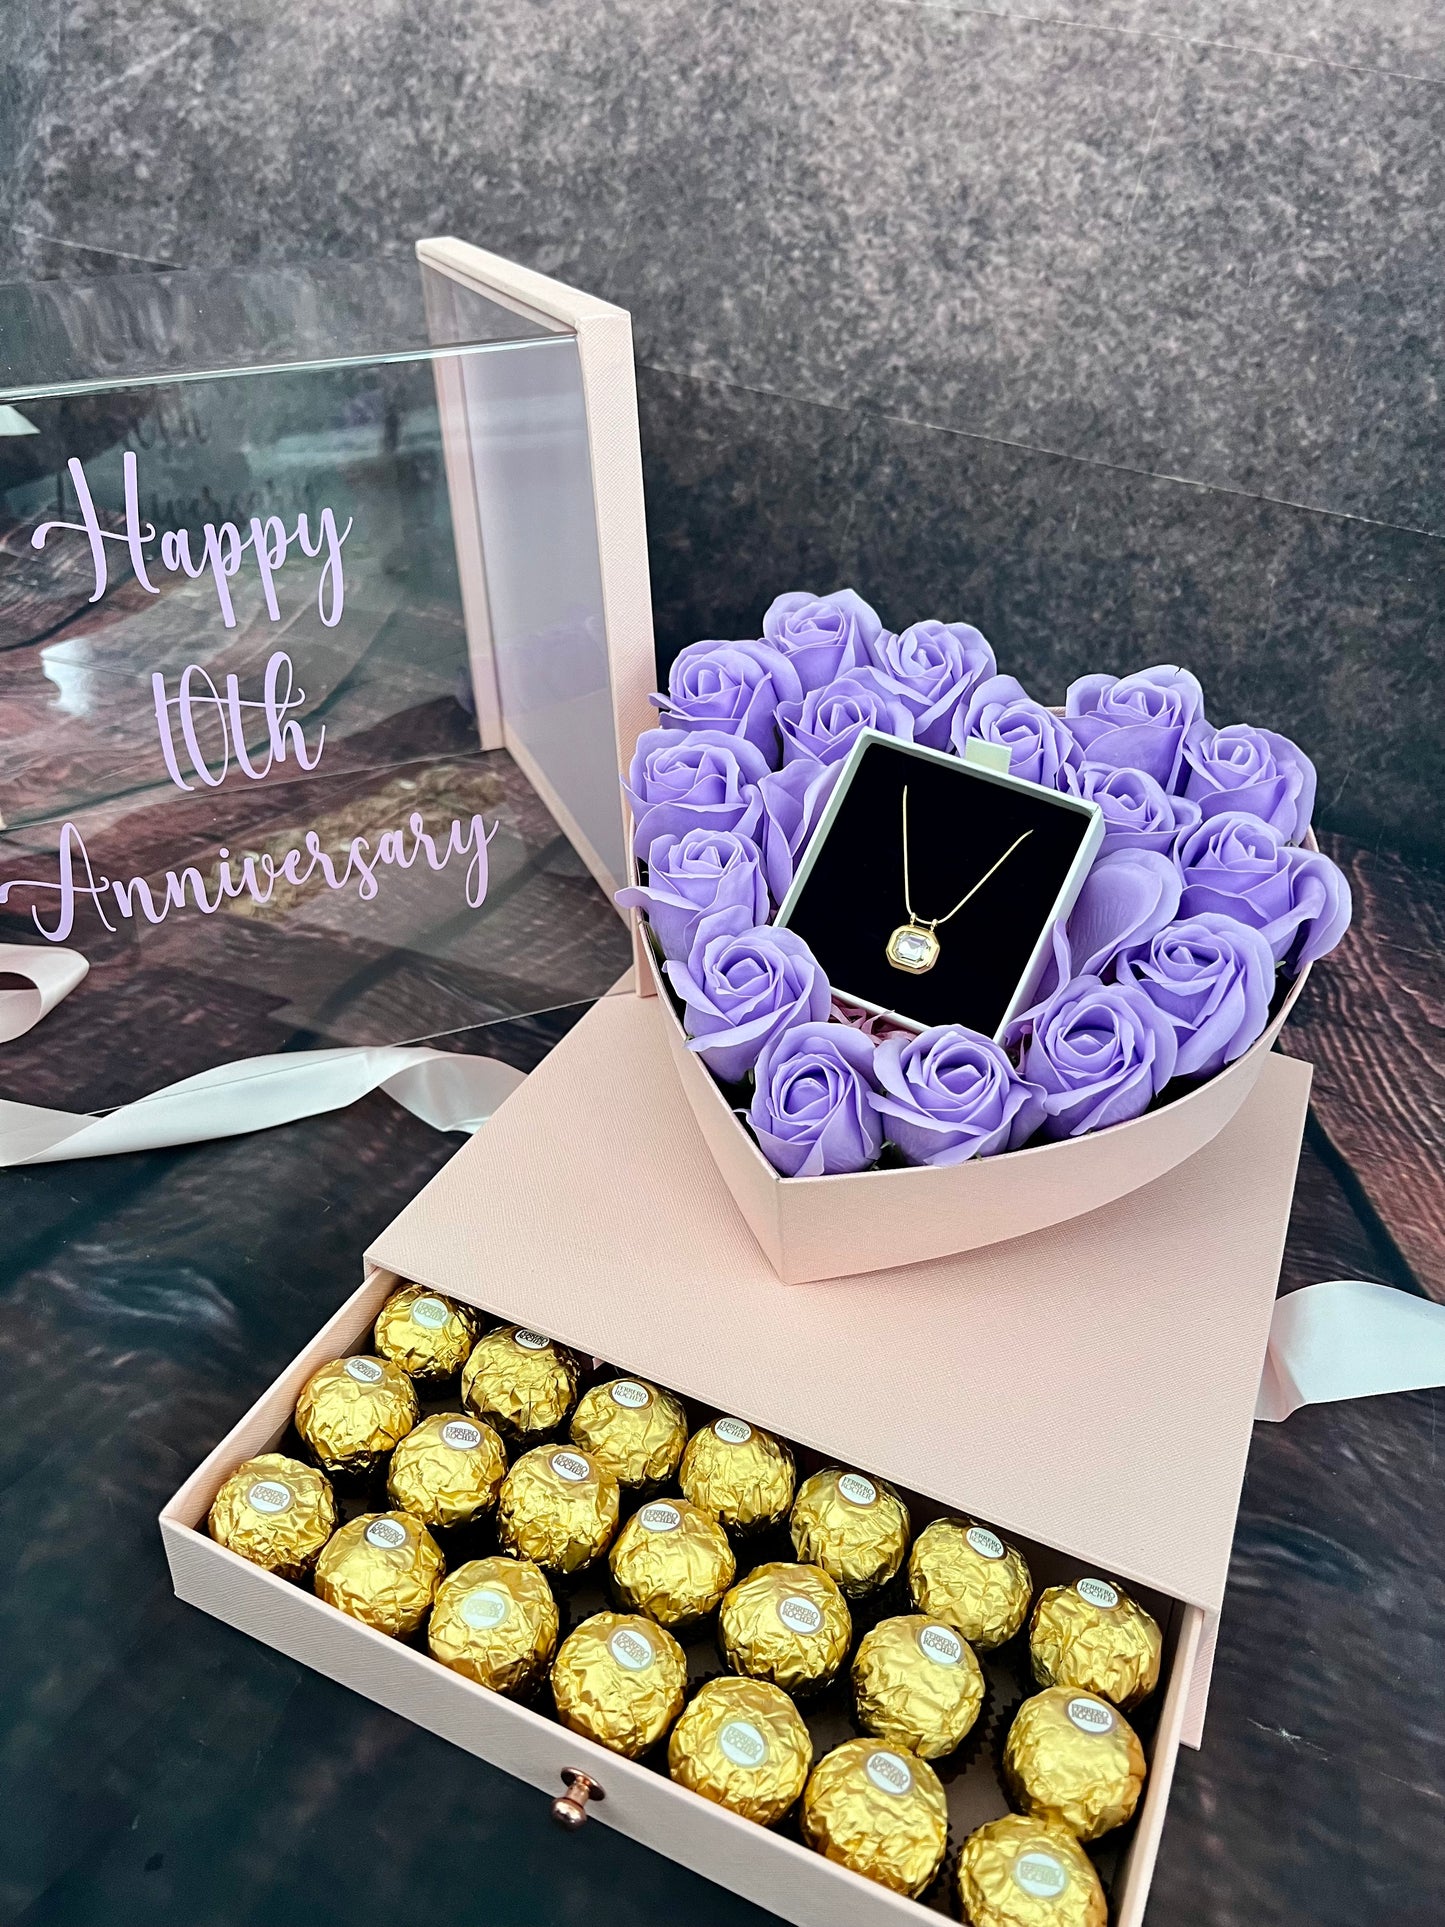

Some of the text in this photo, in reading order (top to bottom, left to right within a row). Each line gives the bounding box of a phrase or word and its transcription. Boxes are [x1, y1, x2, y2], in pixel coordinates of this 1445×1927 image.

[31, 451, 353, 627] Happy
[152, 651, 326, 791] 10th
[0, 811, 499, 942] Anniversary
[717, 1425, 746, 1439] ROCHER
[720, 1420, 749, 1435] FERRERO
[841, 1481, 872, 1500] ROCHER
[844, 1477, 874, 1495] FERRERO
[1080, 1586, 1113, 1604] ROCHER
[1081, 1581, 1115, 1598] FERRERO
[782, 1607, 816, 1627] ROCHER
[784, 1601, 818, 1619] FERRERO
[923, 1637, 957, 1658] ROCHER
[925, 1630, 958, 1650] FERRERO
